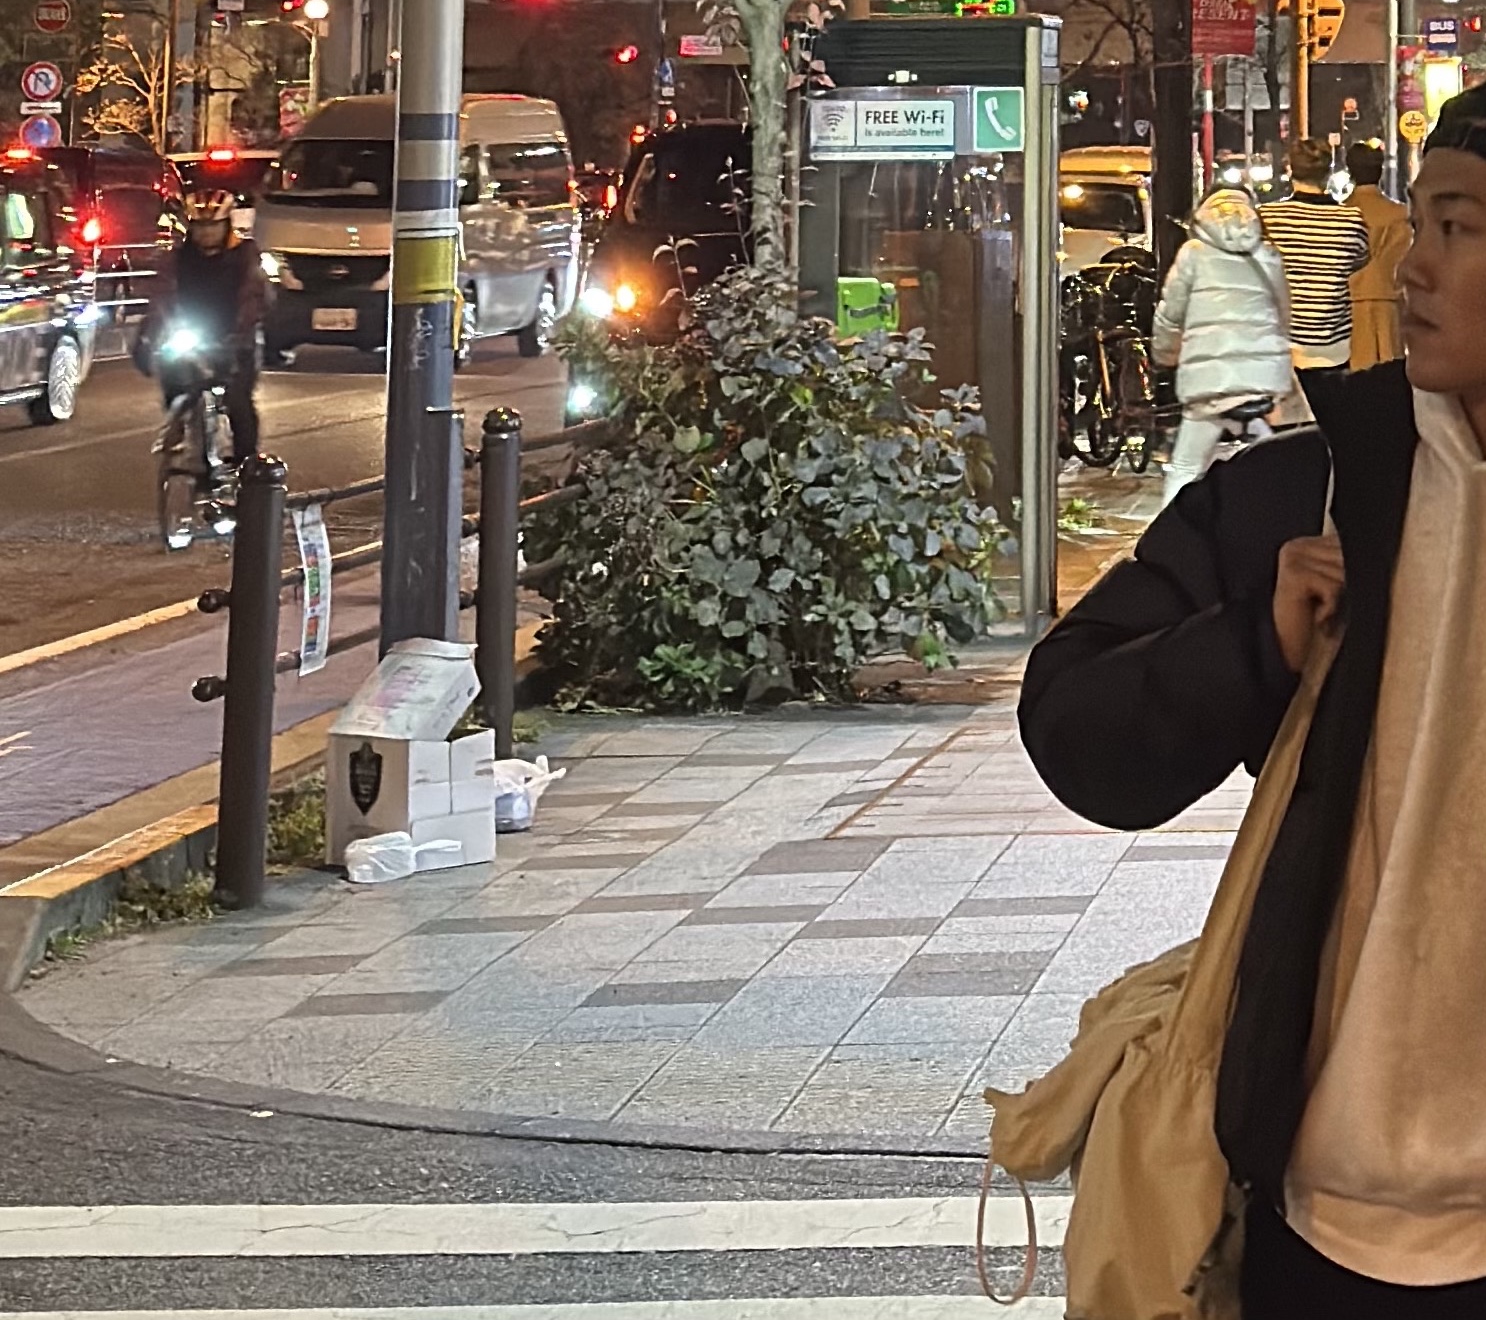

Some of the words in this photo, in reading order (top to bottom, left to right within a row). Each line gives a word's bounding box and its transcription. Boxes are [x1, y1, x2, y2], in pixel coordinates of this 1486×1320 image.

[865, 110, 899, 124] FREE
[904, 109, 945, 124] Wi-Fi
[875, 128, 917, 137] available
